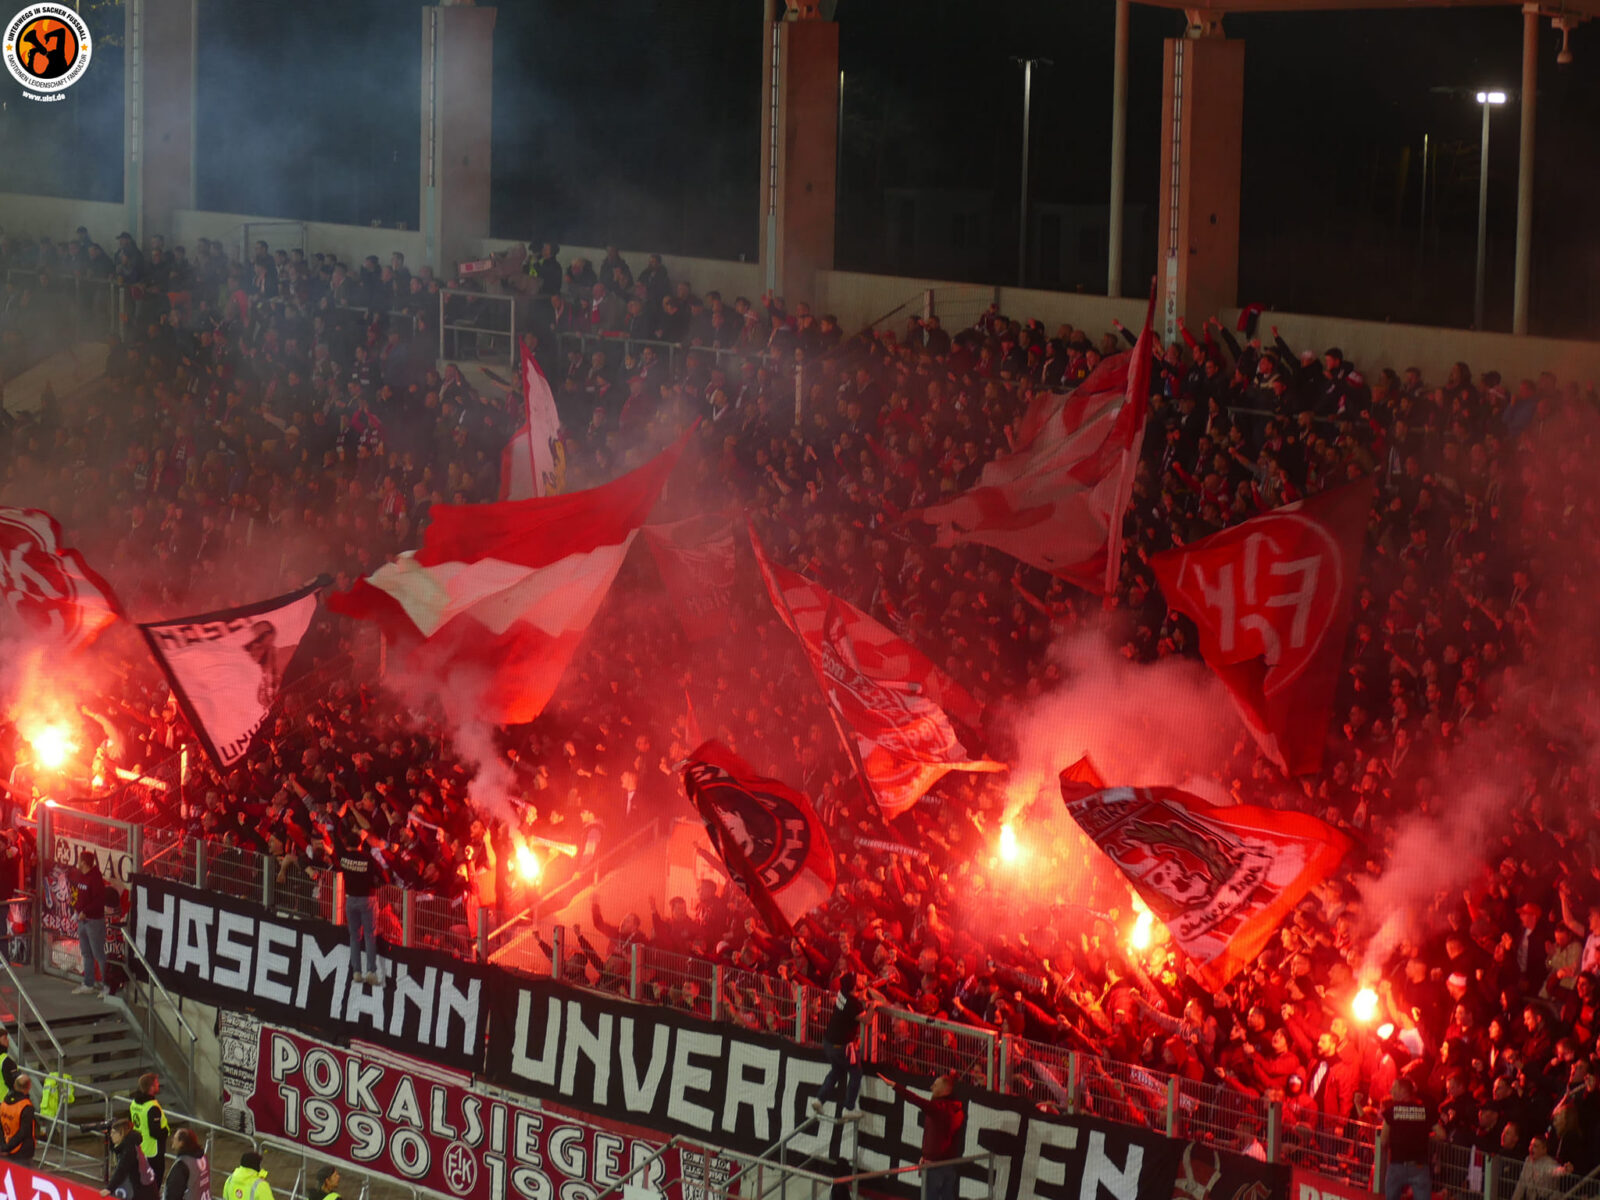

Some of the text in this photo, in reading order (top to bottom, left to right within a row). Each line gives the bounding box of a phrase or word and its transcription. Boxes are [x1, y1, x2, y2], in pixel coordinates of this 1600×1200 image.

[134, 886, 481, 1056] HASEMANN
[270, 1033, 669, 1200] POKALSIEGER
[278, 1084, 432, 1179] 1990
